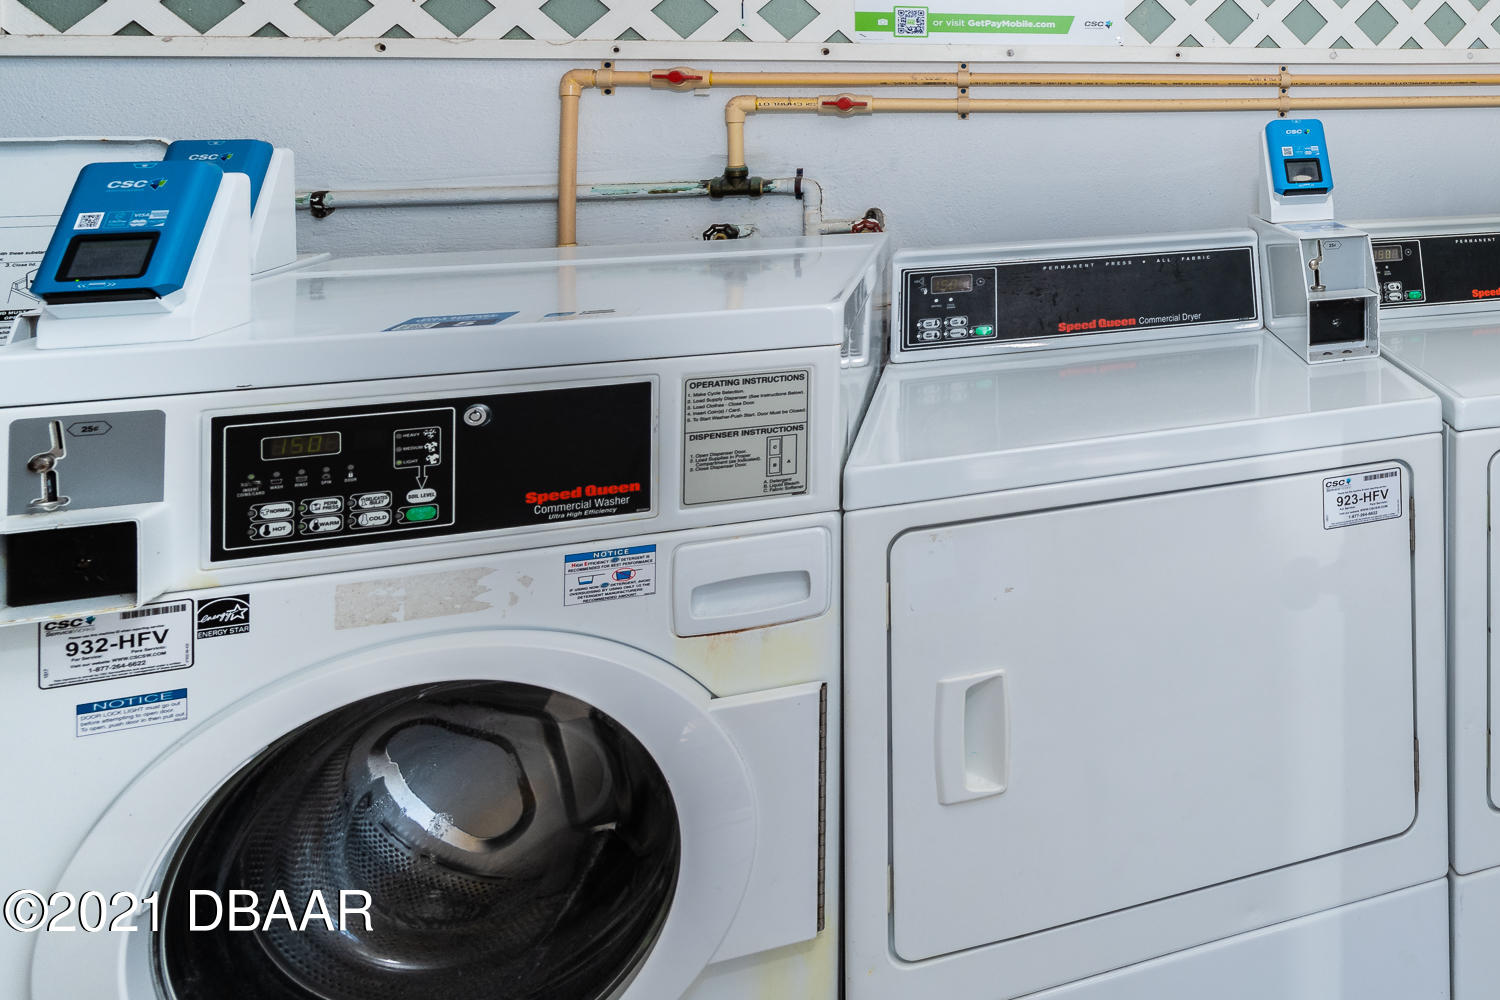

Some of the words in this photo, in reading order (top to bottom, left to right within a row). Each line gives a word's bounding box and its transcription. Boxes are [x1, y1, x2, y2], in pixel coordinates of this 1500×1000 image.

[932, 19, 944, 27] or
[946, 18, 965, 27] visit
[967, 19, 1056, 30] GetPayMobile.com
[188, 153, 219, 161] CSC
[107, 179, 150, 189] CSC
[1042, 262, 1095, 271] PERMANENT
[1058, 319, 1097, 333] Speed
[1098, 317, 1137, 329] Queen
[1138, 314, 1181, 325] Commercial
[1182, 313, 1202, 322] Dryer
[689, 379, 740, 390] OPERATING
[742, 374, 805, 385] INSTRUCTIONS
[80, 424, 100, 434] 25¢
[689, 430, 739, 441] DISPENSER
[741, 424, 804, 436] INSTRUCTIONS
[1325, 480, 1345, 488] CSC
[525, 486, 582, 505] Speed
[584, 482, 640, 497] Queen
[1336, 489, 1389, 507] 923-HFV
[534, 499, 592, 515] Commercial
[594, 496, 630, 508] Washer
[584, 507, 618, 516] Efficiency
[319, 519, 340, 527] WARM
[368, 514, 387, 522] COLD
[593, 549, 630, 558] NOTICE
[44, 617, 83, 631] CSC
[198, 628, 228, 638] ENERGY
[229, 625, 250, 635] STAR
[65, 629, 169, 657] 932-HFV
[111, 651, 167, 663] WWW.CSCSW.COM
[88, 660, 147, 673] 1-877-264-6622
[93, 691, 173, 711] NOTICE
[123, 706, 144, 715] LIGHT
